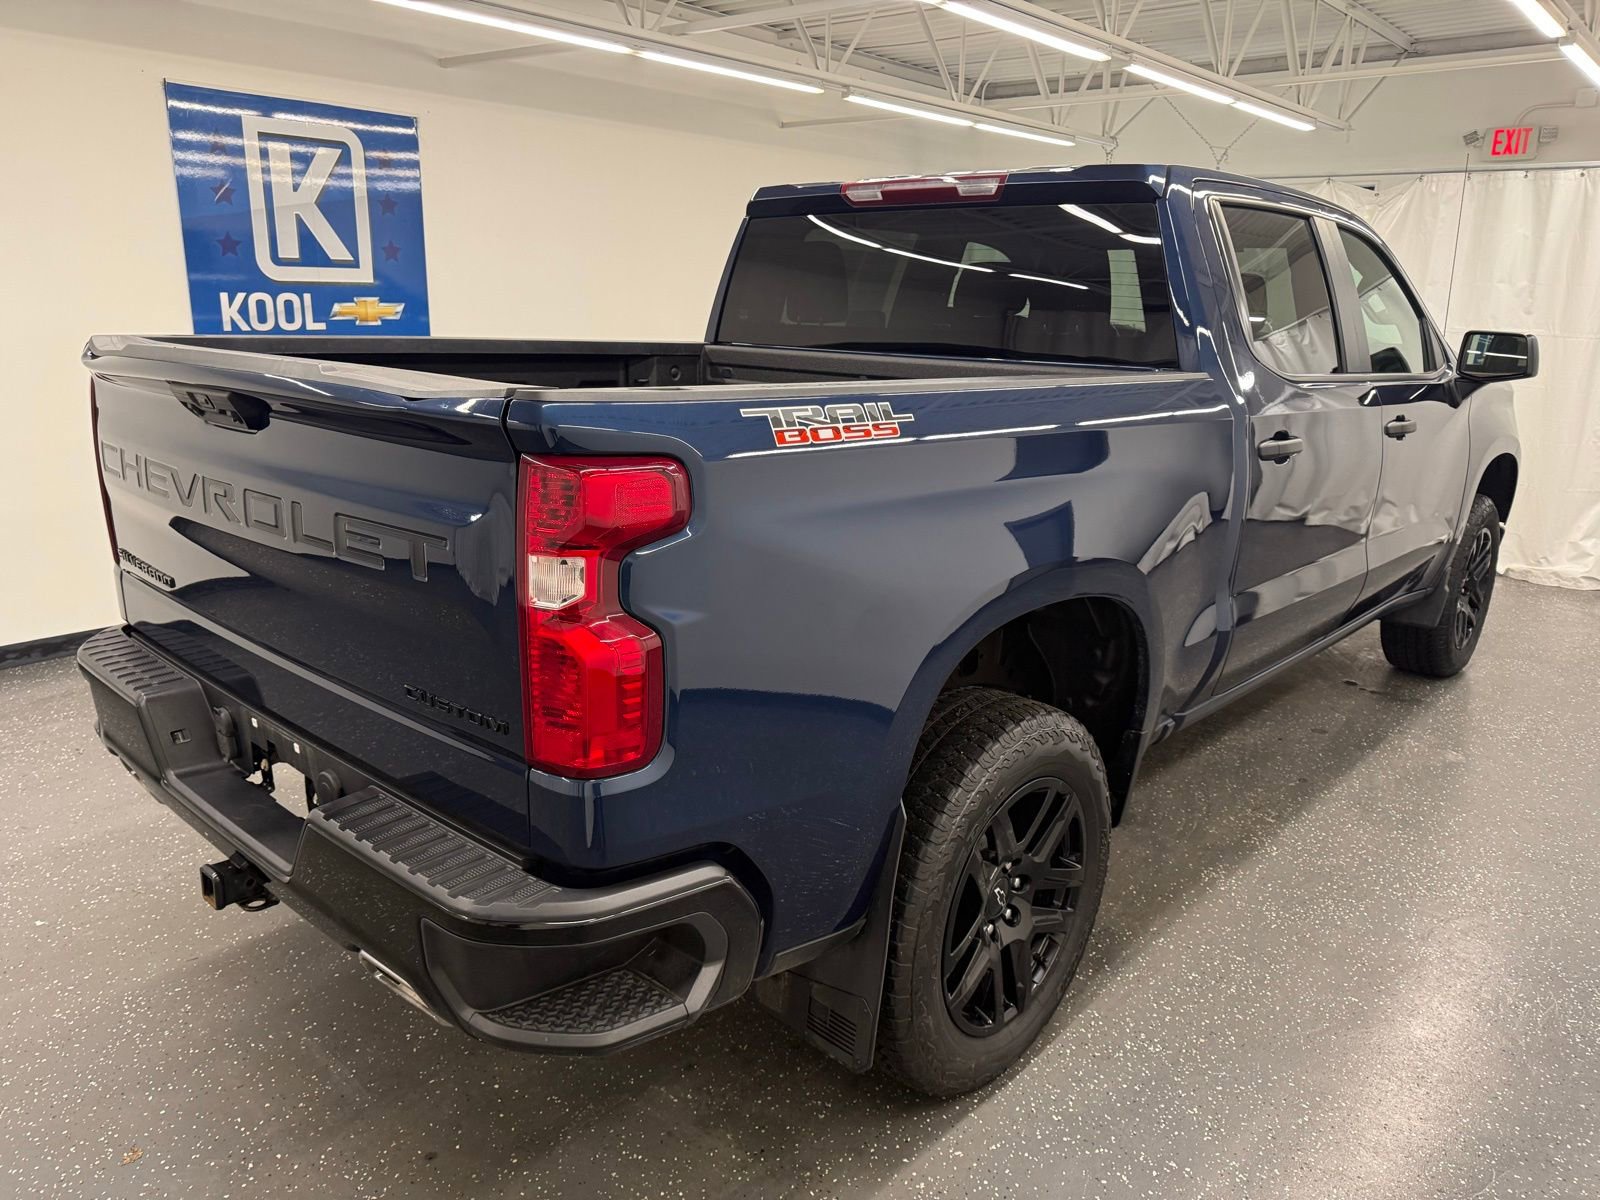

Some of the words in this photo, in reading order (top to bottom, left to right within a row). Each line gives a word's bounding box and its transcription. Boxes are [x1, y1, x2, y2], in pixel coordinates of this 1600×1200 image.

[1491, 127, 1533, 156] EXIT
[267, 141, 354, 261] K
[219, 292, 327, 331] KOOL
[739, 402, 915, 429] TRAIL
[773, 421, 901, 447] BOSS
[101, 439, 450, 583] CHEVROLET
